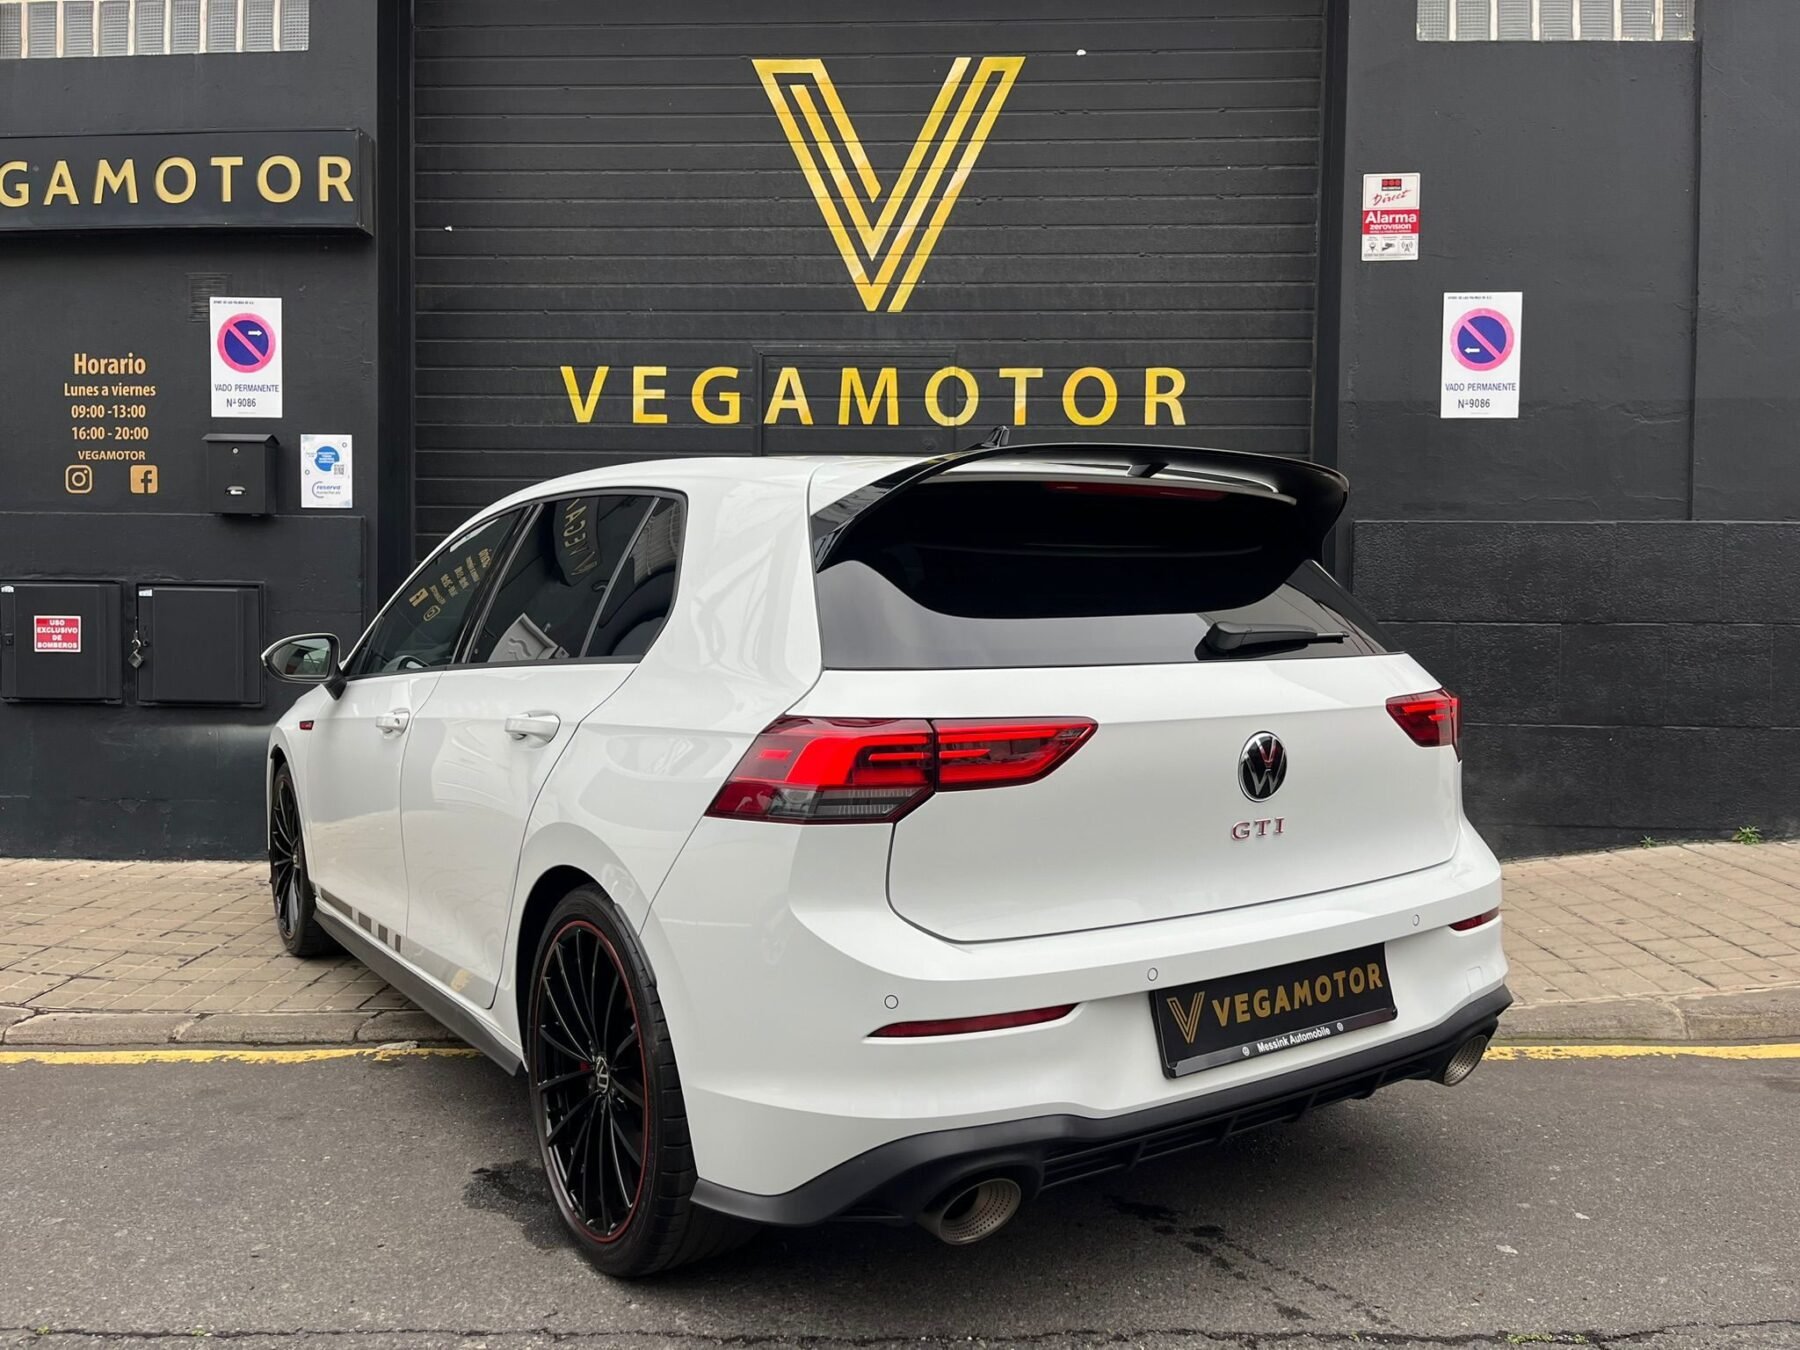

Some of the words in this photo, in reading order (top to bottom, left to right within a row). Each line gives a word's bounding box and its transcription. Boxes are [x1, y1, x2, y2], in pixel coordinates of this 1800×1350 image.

[0, 155, 354, 208] GAMOTOR
[1365, 210, 1417, 224] Alarma
[1369, 223, 1412, 231] zerovision
[73, 353, 147, 375] Horario
[64, 383, 99, 397] Lunes
[101, 386, 109, 397] a
[110, 382, 156, 397] viernes
[214, 383, 232, 392] VADO
[234, 383, 280, 393] PERMANENTE
[1445, 382, 1465, 392] VADO
[1467, 382, 1517, 392] PERMANENTE
[561, 365, 1186, 427] VEGAMOTOR
[71, 404, 106, 418] 09:00
[72, 426, 107, 440] 16:00
[115, 426, 149, 440] 20:00
[78, 450, 146, 461] VEGAMOTOR
[1230, 816, 1285, 842] GTI
[1211, 962, 1384, 1028] VEGAMOTOR
[1257, 1036, 1289, 1053] Messink
[1289, 1026, 1331, 1045] Automobile
